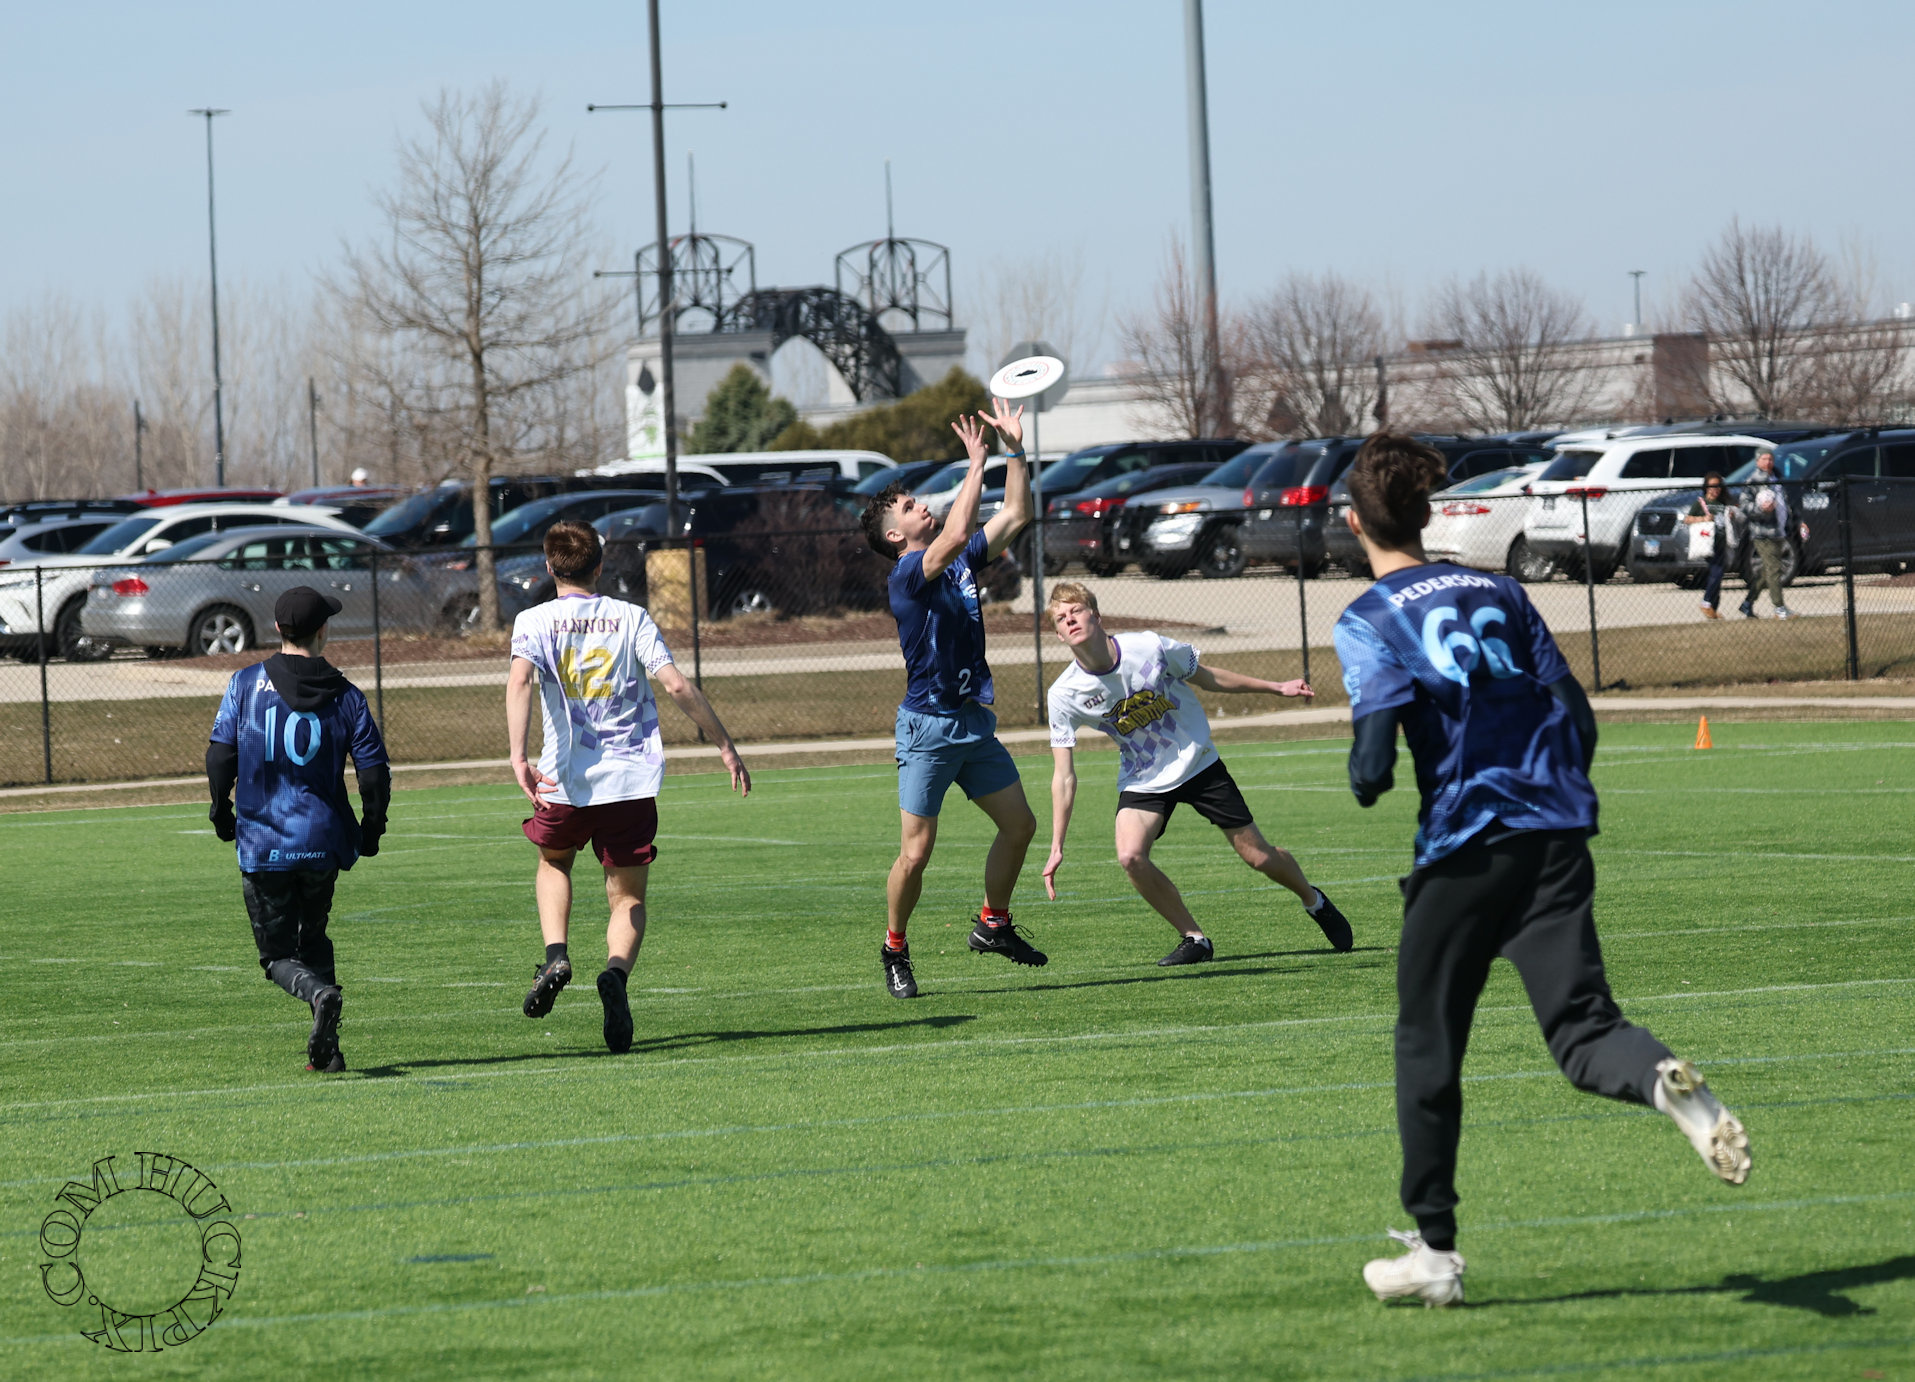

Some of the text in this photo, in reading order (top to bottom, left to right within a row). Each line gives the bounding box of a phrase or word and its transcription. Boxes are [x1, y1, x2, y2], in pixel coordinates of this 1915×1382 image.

[1388, 575, 1497, 608] PEDERSON
[1422, 606, 1524, 687] 66
[958, 668, 972, 696] 2
[265, 705, 322, 766] 10
[285, 851, 326, 860] ULTIMATE
